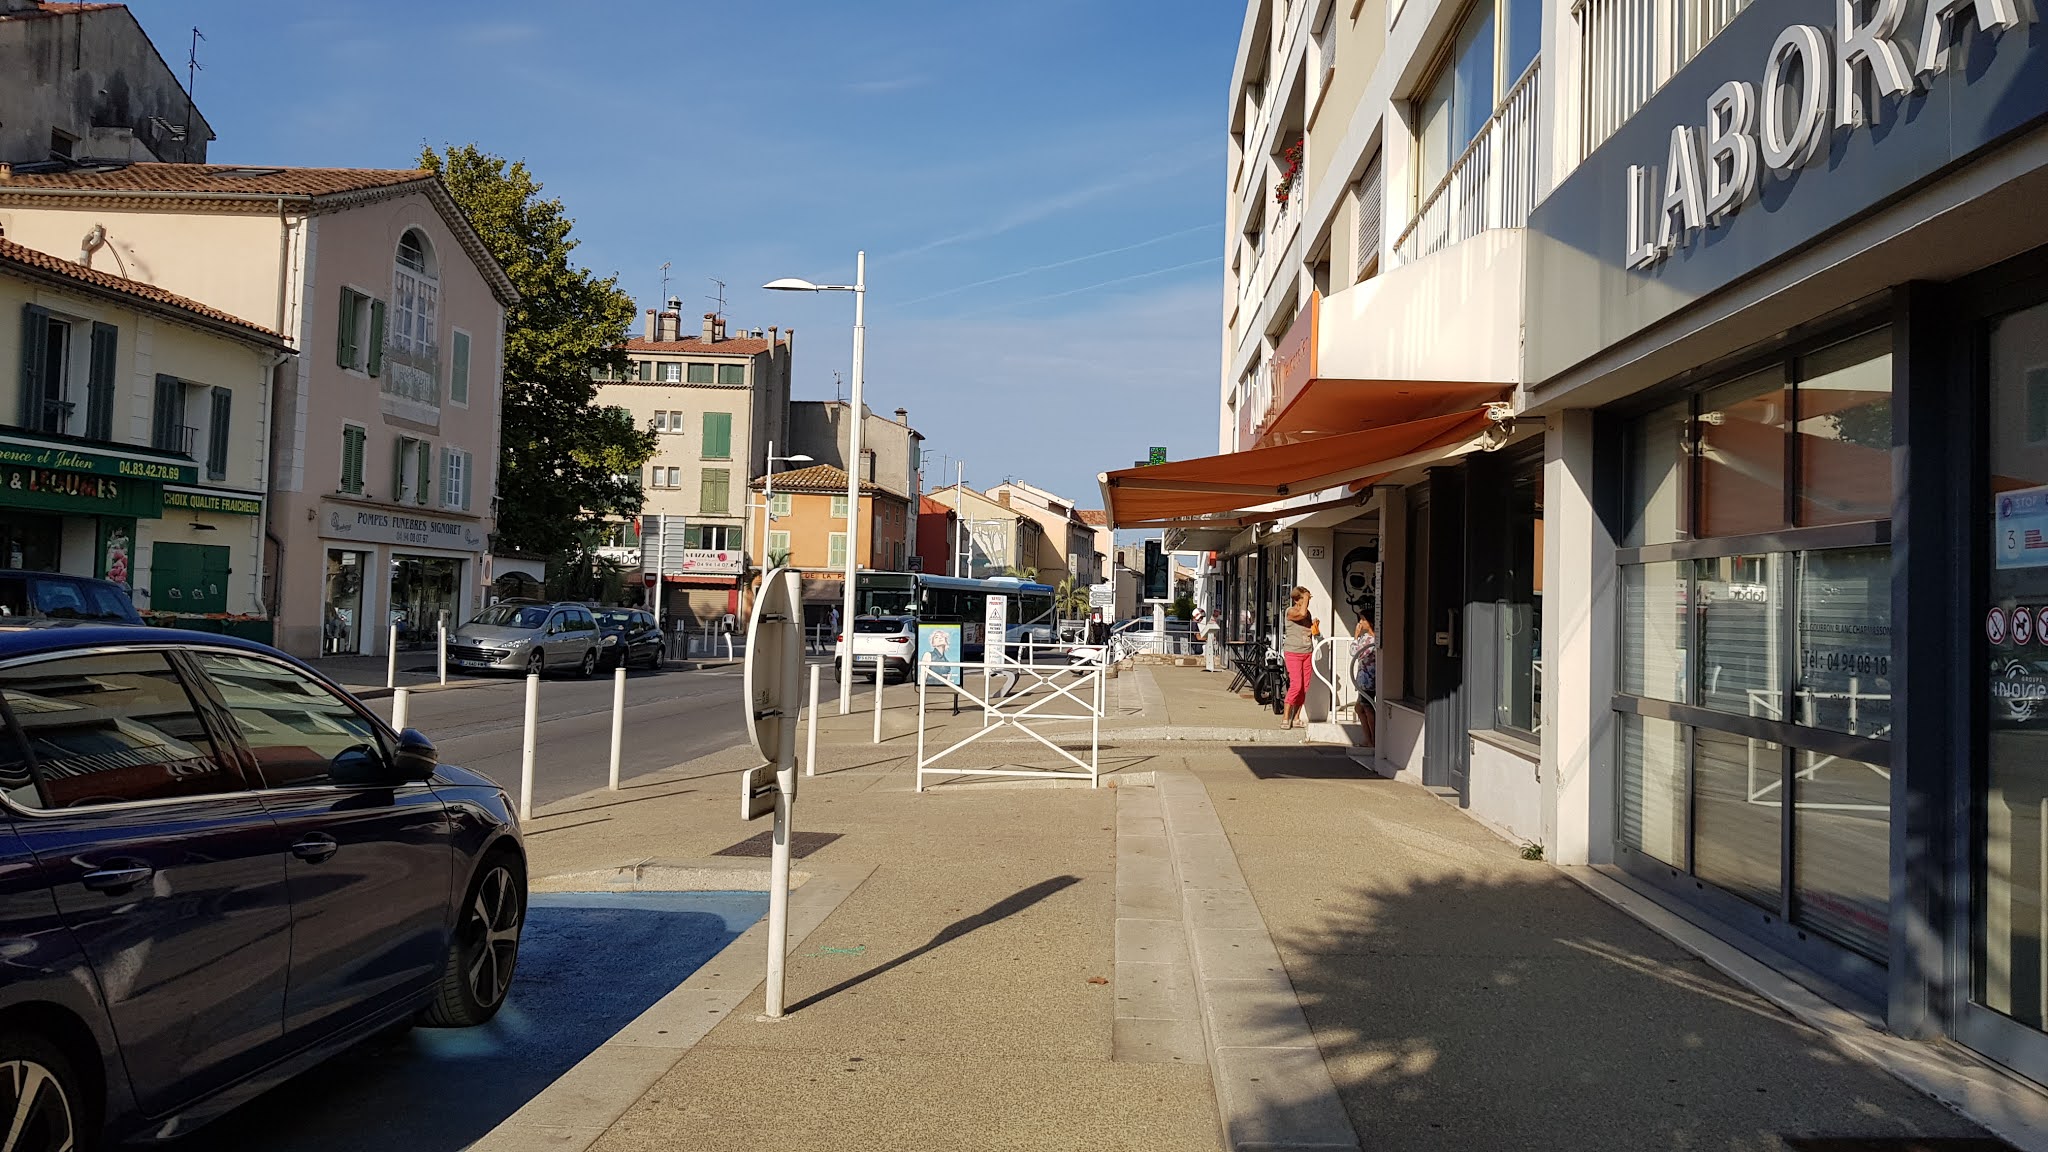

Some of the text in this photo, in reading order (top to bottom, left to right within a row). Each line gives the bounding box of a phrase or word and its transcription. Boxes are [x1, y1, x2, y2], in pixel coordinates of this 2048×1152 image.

[37, 449, 51, 463] et
[53, 451, 95, 469] Julien
[163, 492, 260, 513] CHOIX QUALITE FRAICHEUR
[357, 512, 462, 536] POMPES FUNEBRES SIGNORET
[2007, 530, 2016, 550] 3
